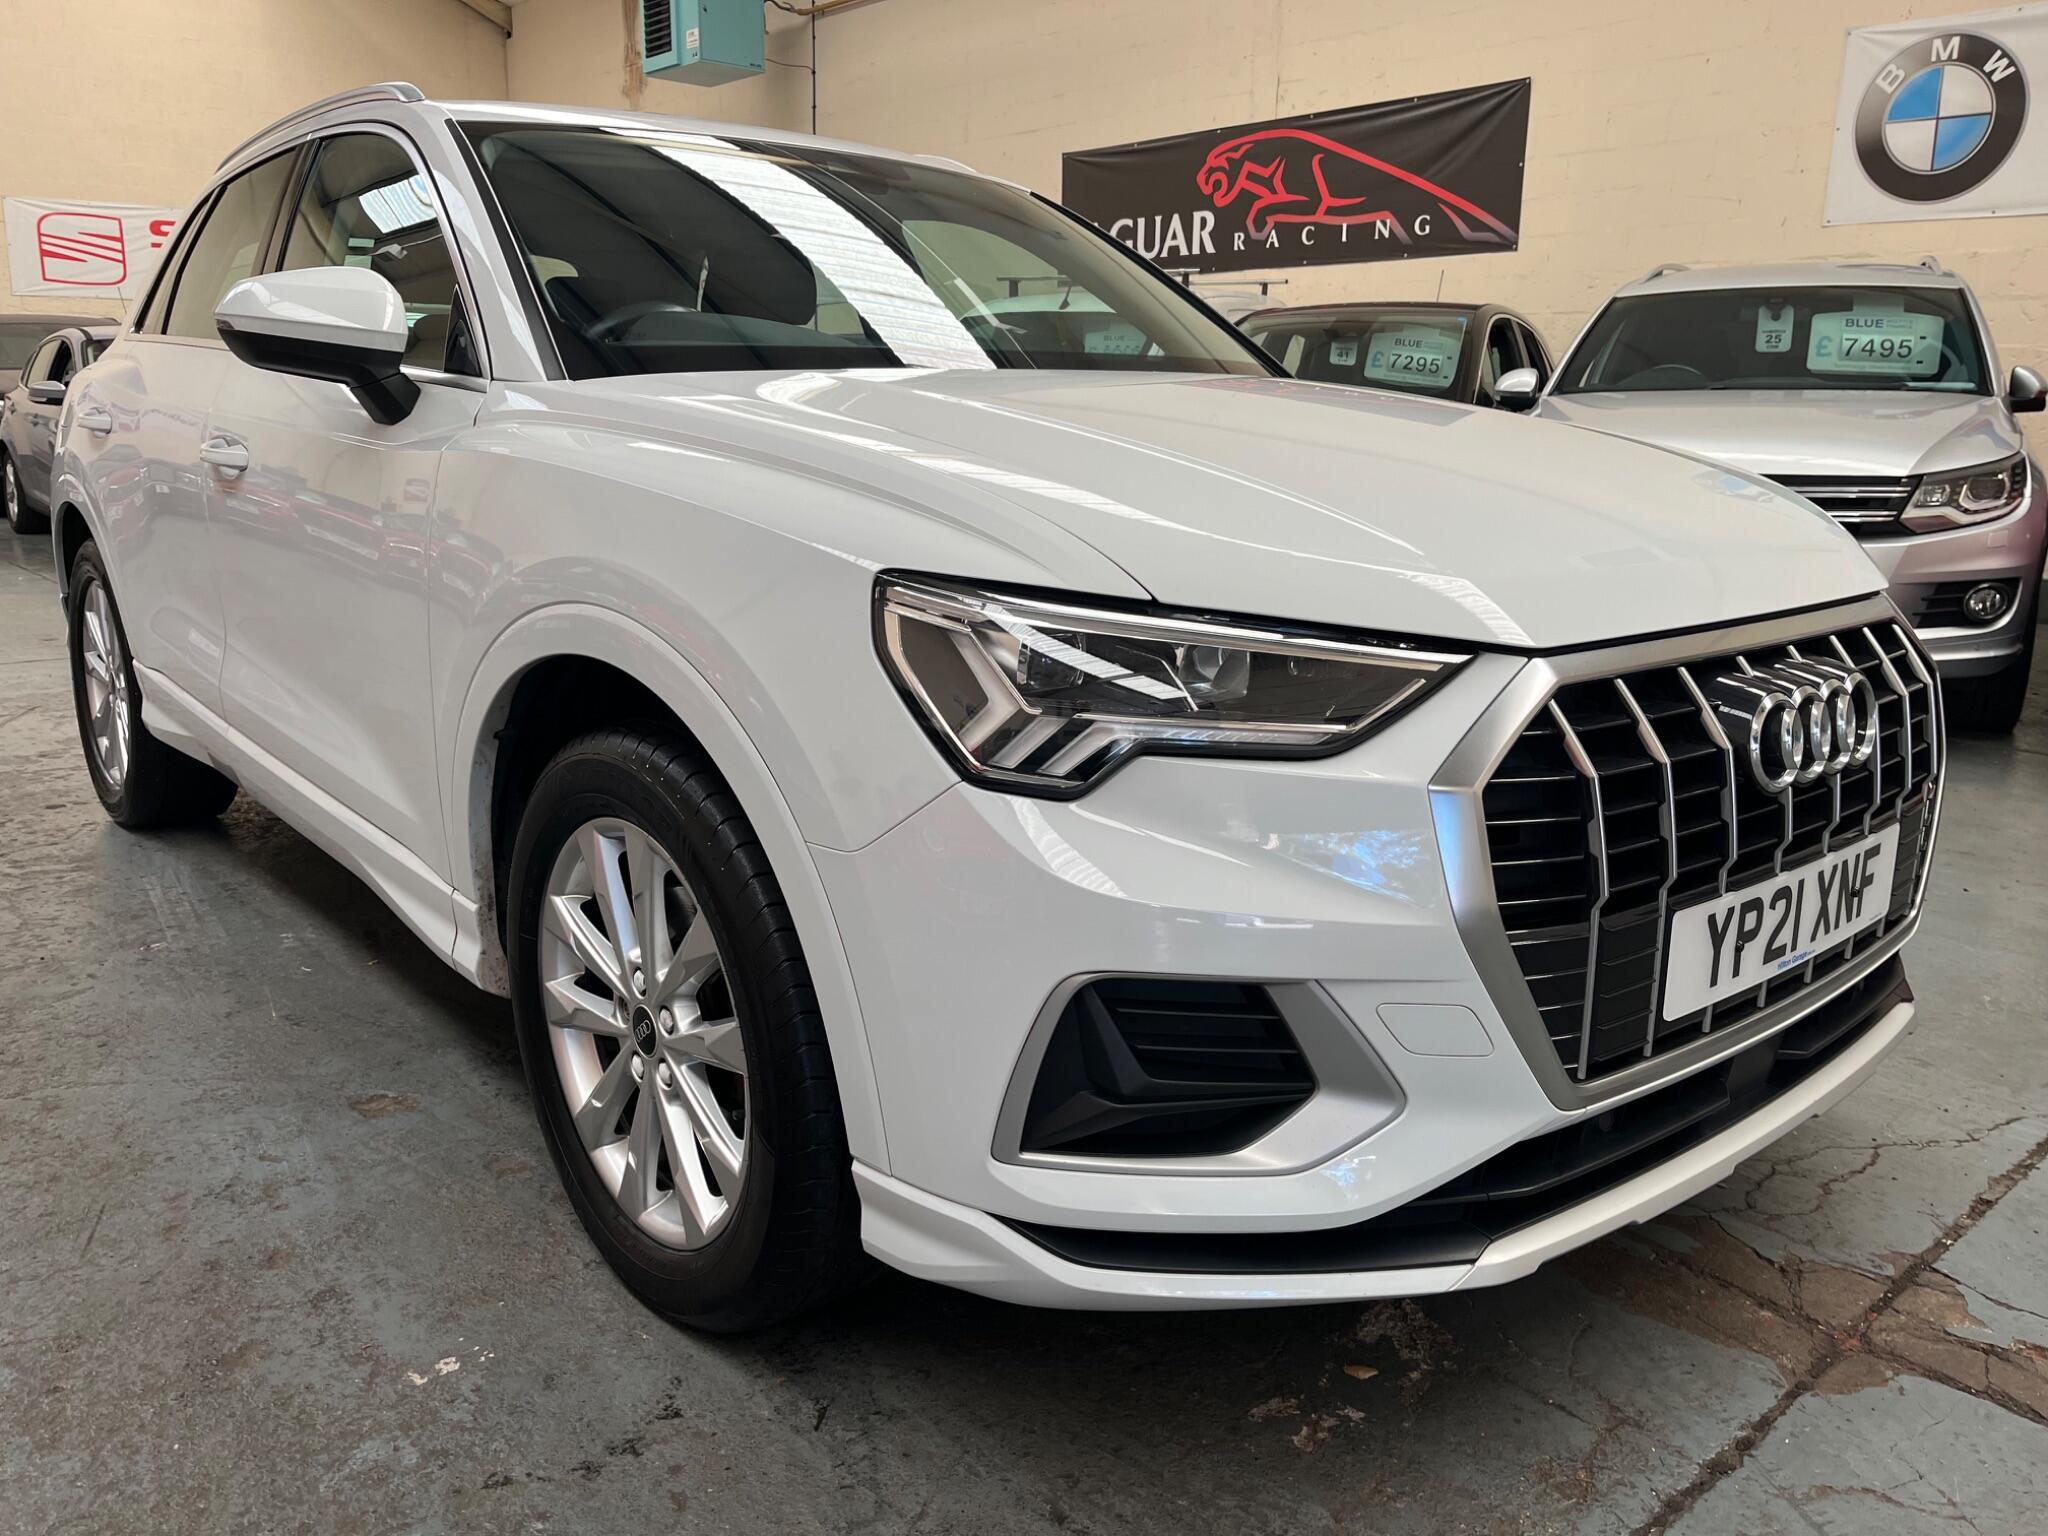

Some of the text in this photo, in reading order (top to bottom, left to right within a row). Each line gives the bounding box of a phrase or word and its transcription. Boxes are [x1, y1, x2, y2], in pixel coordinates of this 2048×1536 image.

[1875, 36, 2016, 95] BMW
[1233, 215, 1431, 251] RACING
[1845, 318, 1884, 328] BLUE
[1395, 338, 1424, 349] BLUE
[1765, 334, 1782, 344] 25
[1707, 842, 1882, 988] YP21 XNF
